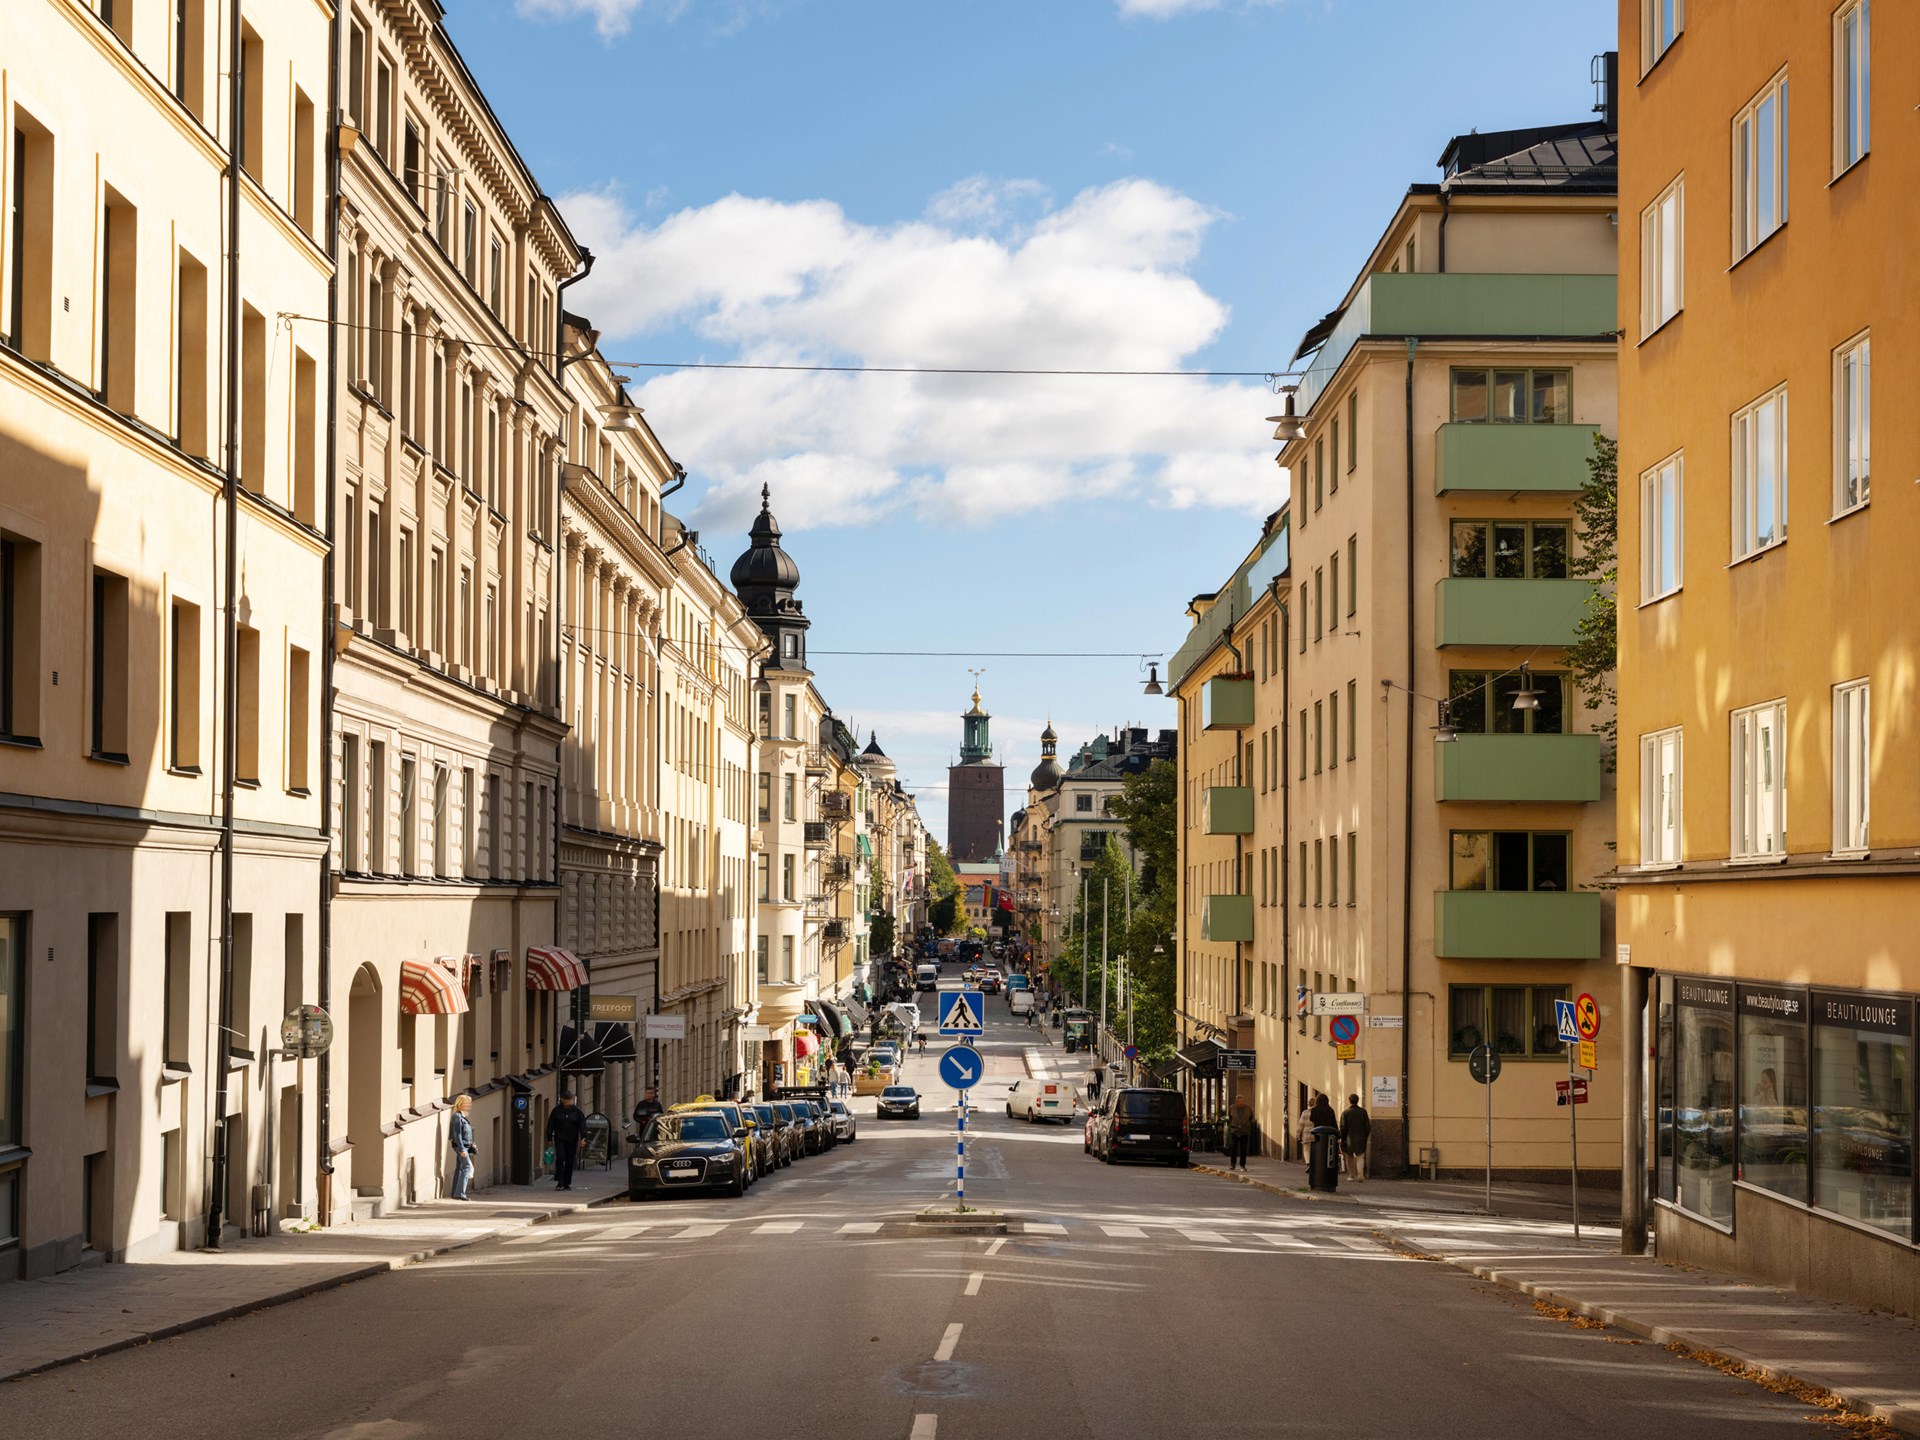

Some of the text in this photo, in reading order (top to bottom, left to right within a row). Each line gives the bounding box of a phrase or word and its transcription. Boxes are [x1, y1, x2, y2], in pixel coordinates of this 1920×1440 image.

[1682, 986, 1728, 1004] BEAUTYLOUNGE
[1746, 993, 1799, 1015] www.beautylounge.se
[592, 1004, 632, 1012] FREEFOOT
[1827, 1002, 1896, 1025] BEAUTYLOUNGE
